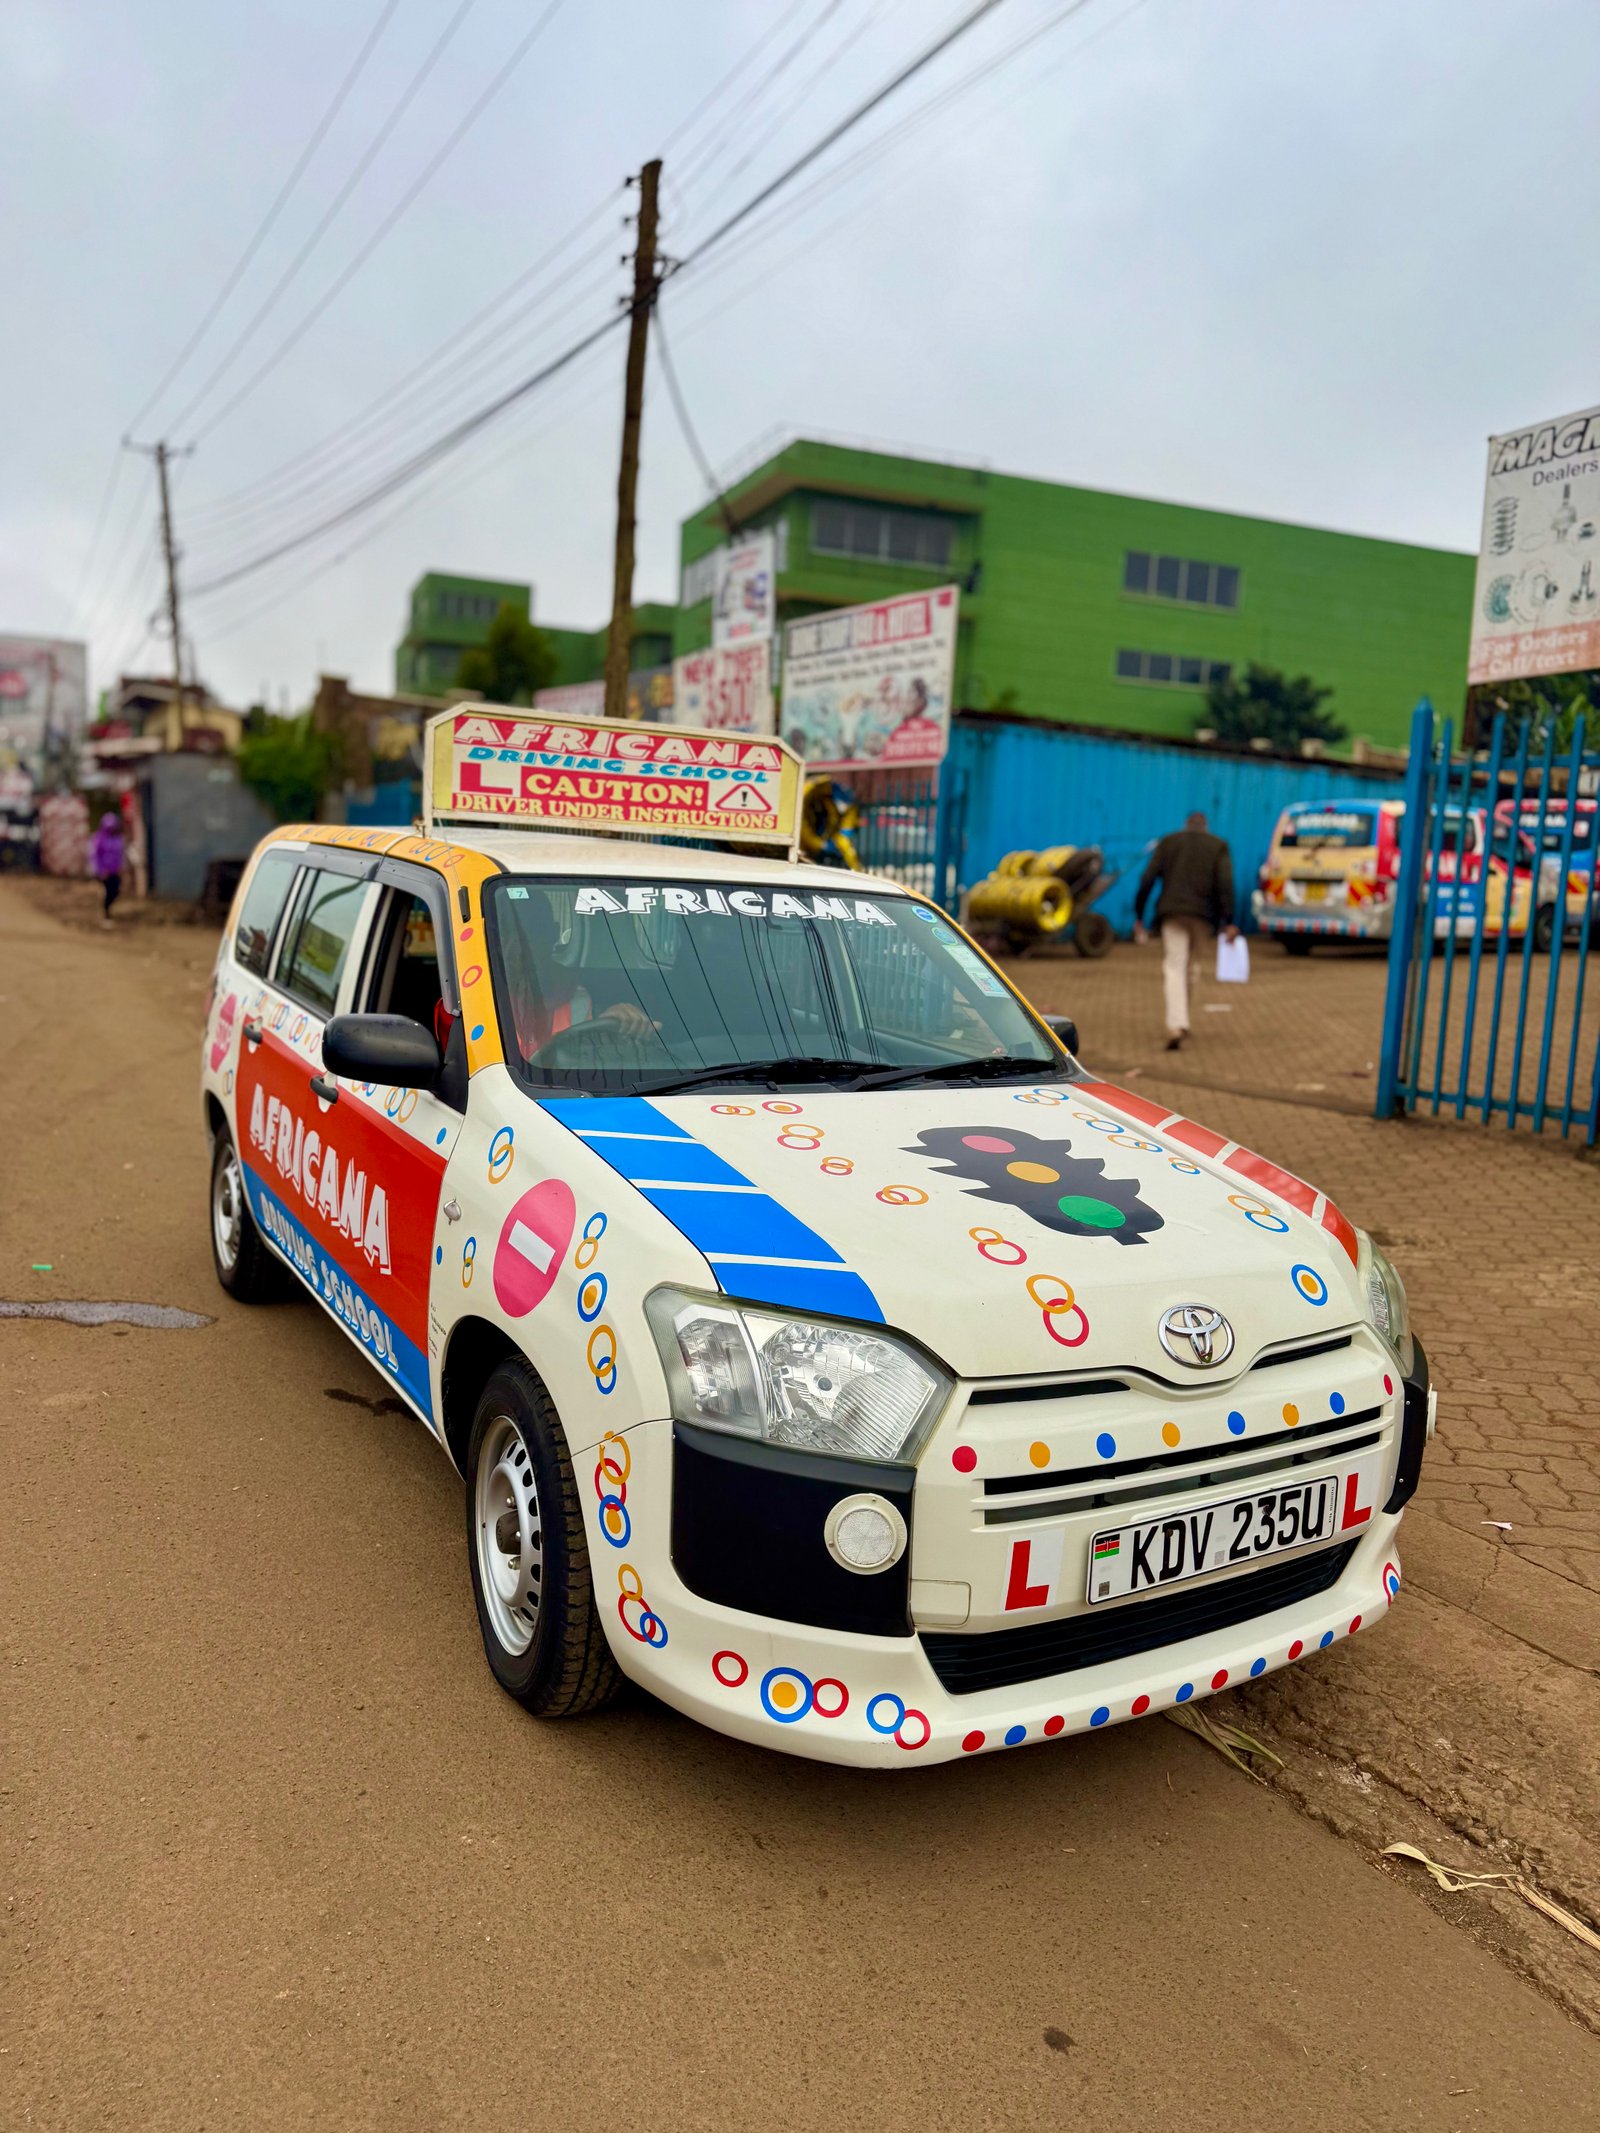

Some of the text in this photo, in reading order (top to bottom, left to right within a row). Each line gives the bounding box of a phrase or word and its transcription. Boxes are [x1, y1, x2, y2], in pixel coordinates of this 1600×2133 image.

[1532, 459, 1599, 487] Dealers
[454, 718, 781, 770] AFRICANA
[468, 747, 768, 784] DRIVING SCHOOL
[460, 762, 513, 795] L
[526, 773, 704, 807] CAUTION!
[455, 793, 777, 830] DRIVER UNDER INSTRUCTIONS
[574, 887, 897, 927] AFRICANA
[250, 1083, 391, 1275] AFRICANA
[260, 1191, 399, 1373] DRIVING SCHOOL
[1341, 1472, 1373, 1531] L
[1130, 1511, 1215, 1590] KDV
[1229, 1483, 1327, 1561] 235U
[1004, 1540, 1050, 1611] L
